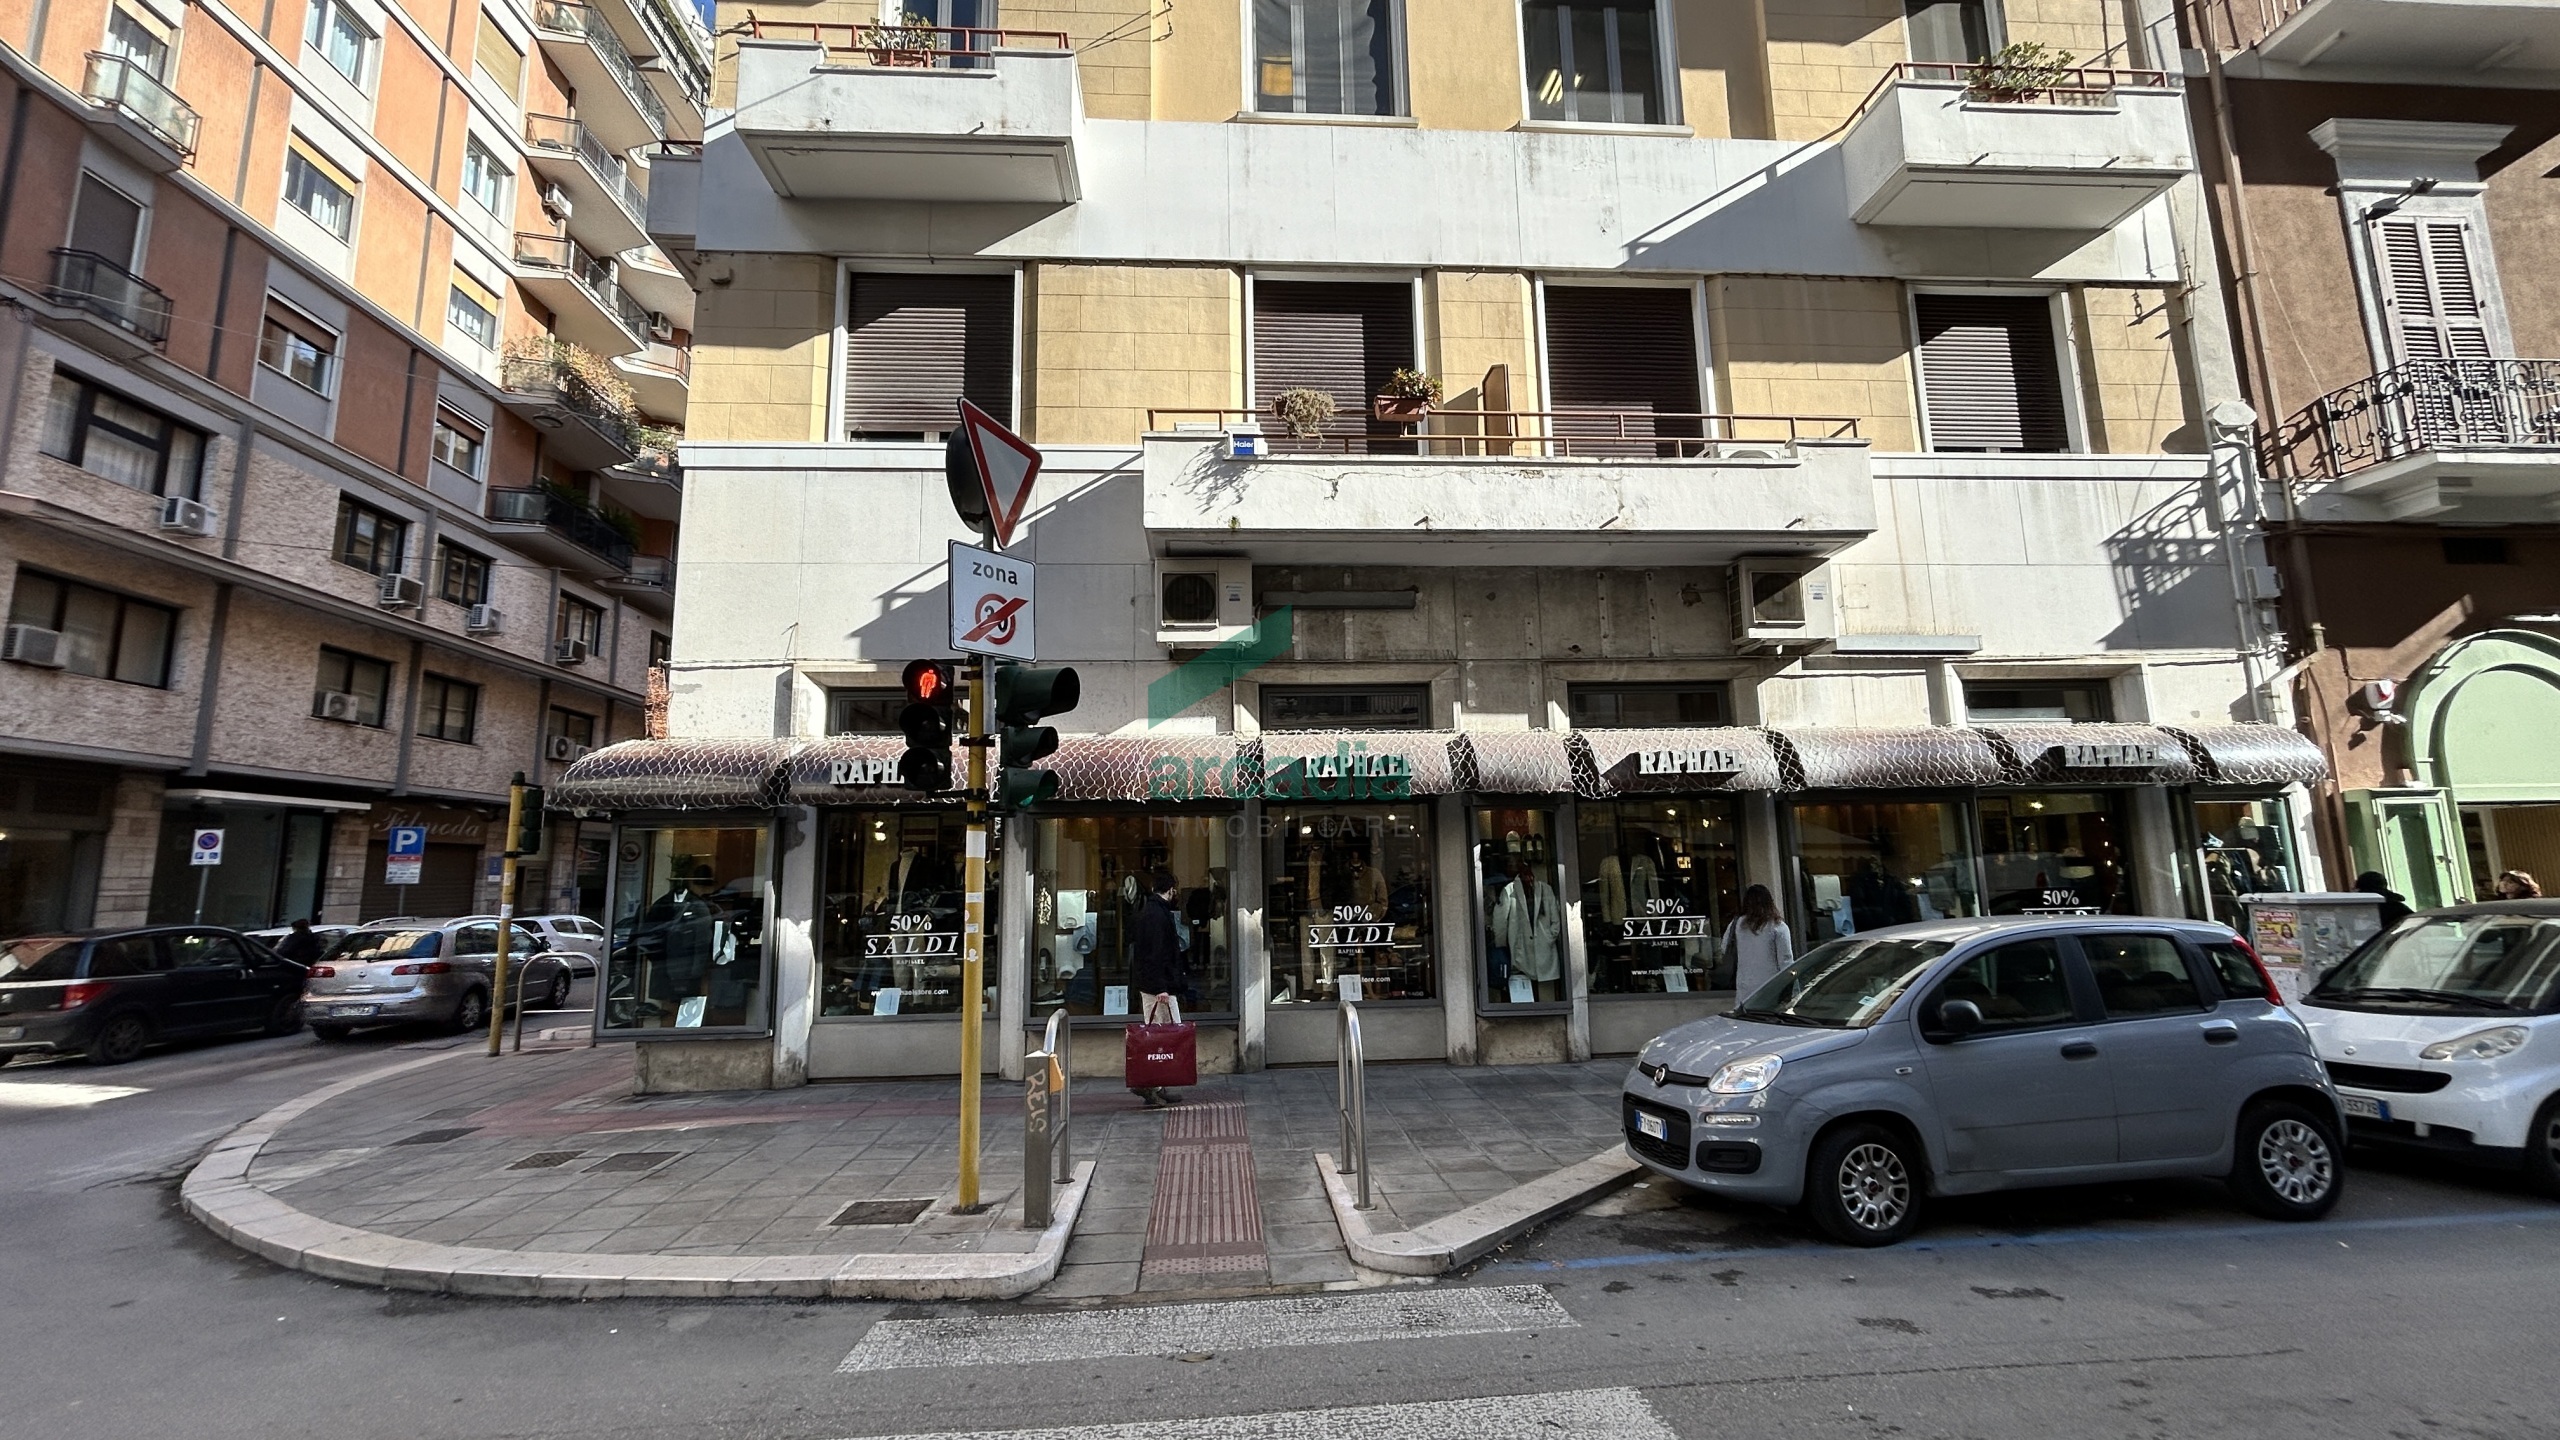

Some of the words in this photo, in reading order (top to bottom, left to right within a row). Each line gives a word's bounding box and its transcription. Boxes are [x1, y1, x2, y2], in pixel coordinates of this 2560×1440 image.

[1233, 440, 1254, 448] Haier
[972, 561, 1018, 586] zona
[1638, 749, 1747, 775] RAPHAEL
[2064, 744, 2168, 767] RAPHAEL
[829, 759, 905, 785] RAPH
[1304, 753, 1415, 778] RAPHAEL
[395, 829, 418, 853] P
[1645, 898, 1685, 915] 50%
[2042, 889, 2080, 906] 50%
[1332, 904, 1373, 922] 50%
[889, 914, 933, 932] 50%
[1623, 919, 1706, 936] SALDI
[1308, 926, 1395, 944] SALDI
[864, 936, 958, 955] SALDI
[1147, 1053, 1174, 1061] PERONI
